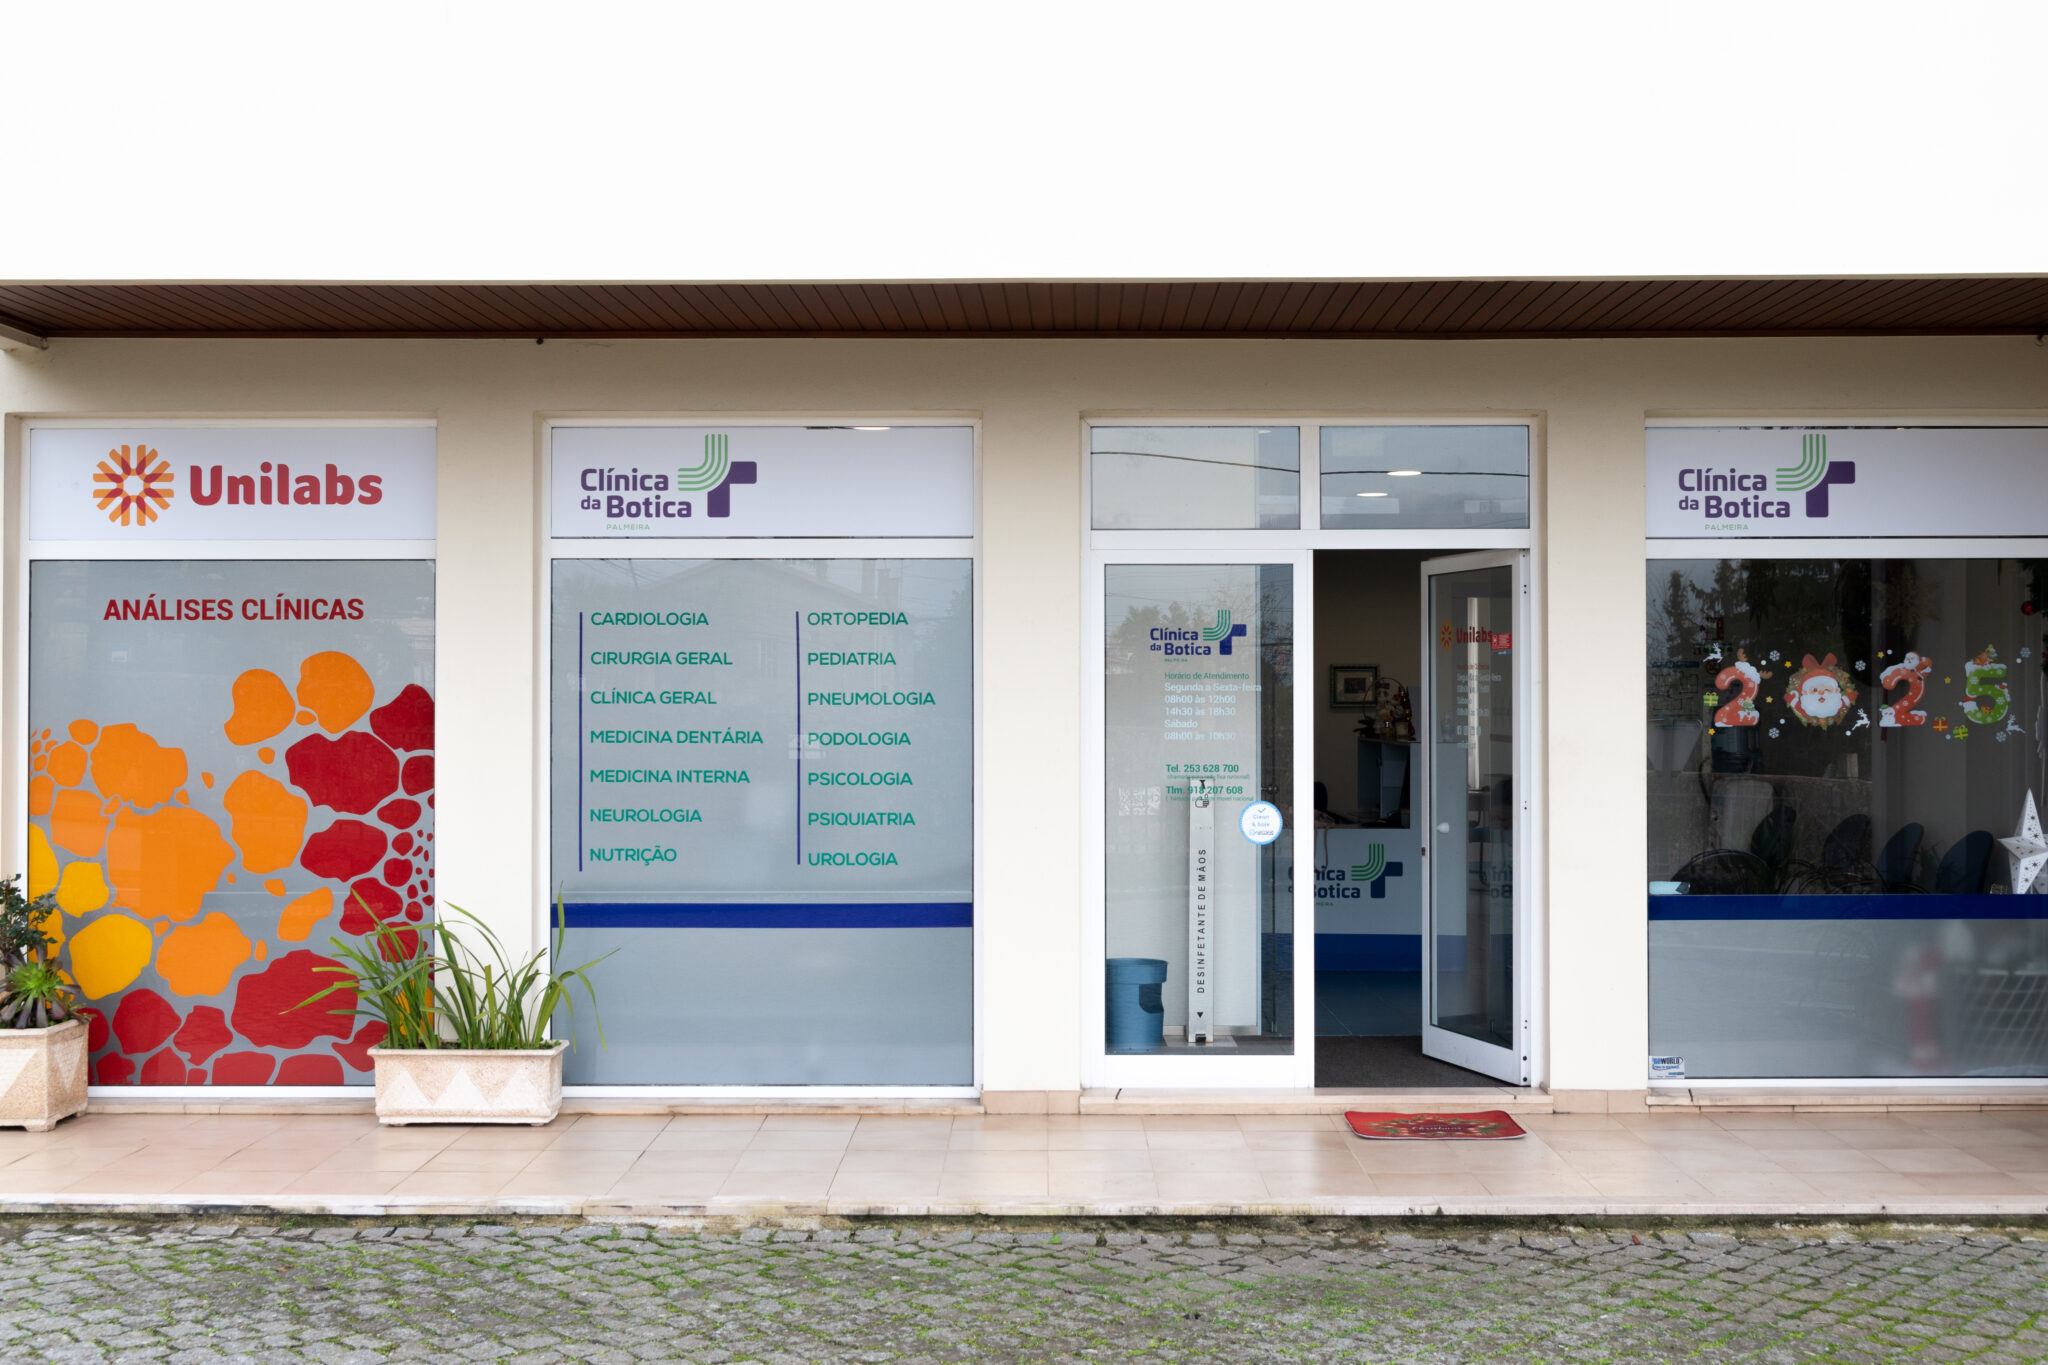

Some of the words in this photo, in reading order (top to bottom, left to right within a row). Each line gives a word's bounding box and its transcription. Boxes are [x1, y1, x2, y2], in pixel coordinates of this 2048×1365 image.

[190, 461, 383, 506] Unilabs
[580, 467, 669, 492] Clínica
[1678, 467, 1767, 492] Clínica
[580, 495, 601, 510] da
[606, 494, 692, 518] Botica
[1678, 495, 1700, 510] da
[1704, 494, 1791, 518] Botica
[606, 523, 651, 531] PALMEIRA
[1704, 523, 1749, 531] PALMEIRA
[103, 593, 234, 621] ANÁLISES
[241, 593, 364, 621] CLÍNICAS
[590, 611, 710, 627] CARDIOLOGIA
[807, 611, 909, 627] ORTOPEDIA
[1149, 627, 1199, 641] Clínica
[1149, 643, 1162, 651] da
[1164, 642, 1212, 656] Botica
[590, 650, 673, 666] CIRURGIA
[675, 651, 734, 666] GERAL
[807, 652, 897, 667] PEDIATRIA
[1164, 672, 1192, 680] Horário
[1193, 672, 1203, 680] de
[1203, 672, 1250, 681] Atendimento
[1164, 683, 1203, 693] Segunda
[1213, 683, 1262, 692] Sexta-feira
[590, 689, 657, 705] CLÍNICA
[659, 691, 718, 705] GERAL
[807, 691, 936, 707] PNEUMOLOGIA
[1164, 695, 1193, 704] 08h00
[1209, 695, 1237, 704] 12h00
[1165, 707, 1193, 716] 14h30
[589, 729, 673, 745] MEDICINA
[676, 727, 764, 745] DENTÁRIA
[807, 731, 912, 747] PODOLOGIA
[589, 769, 673, 785] MEDICINA
[676, 769, 751, 785] INTERNA
[1165, 764, 1181, 774] Tel.
[1183, 764, 1201, 773] 253
[1202, 764, 1220, 773] 628
[1223, 764, 1240, 773] 700
[807, 771, 913, 787] PSICOLOGIA
[1165, 786, 1184, 795] Tlm.
[1207, 786, 1225, 795] 207
[1226, 786, 1244, 795] 608
[589, 808, 703, 824] NEUROLOGIA
[807, 811, 916, 827] PSIQUIATRIA
[589, 844, 678, 866] NUTRIÇÃO
[807, 851, 900, 867] UROLOGIA
[1196, 848, 1207, 882] MÃOS
[1197, 885, 1207, 900] DE
[1196, 904, 1206, 994] DESINFETANTE
